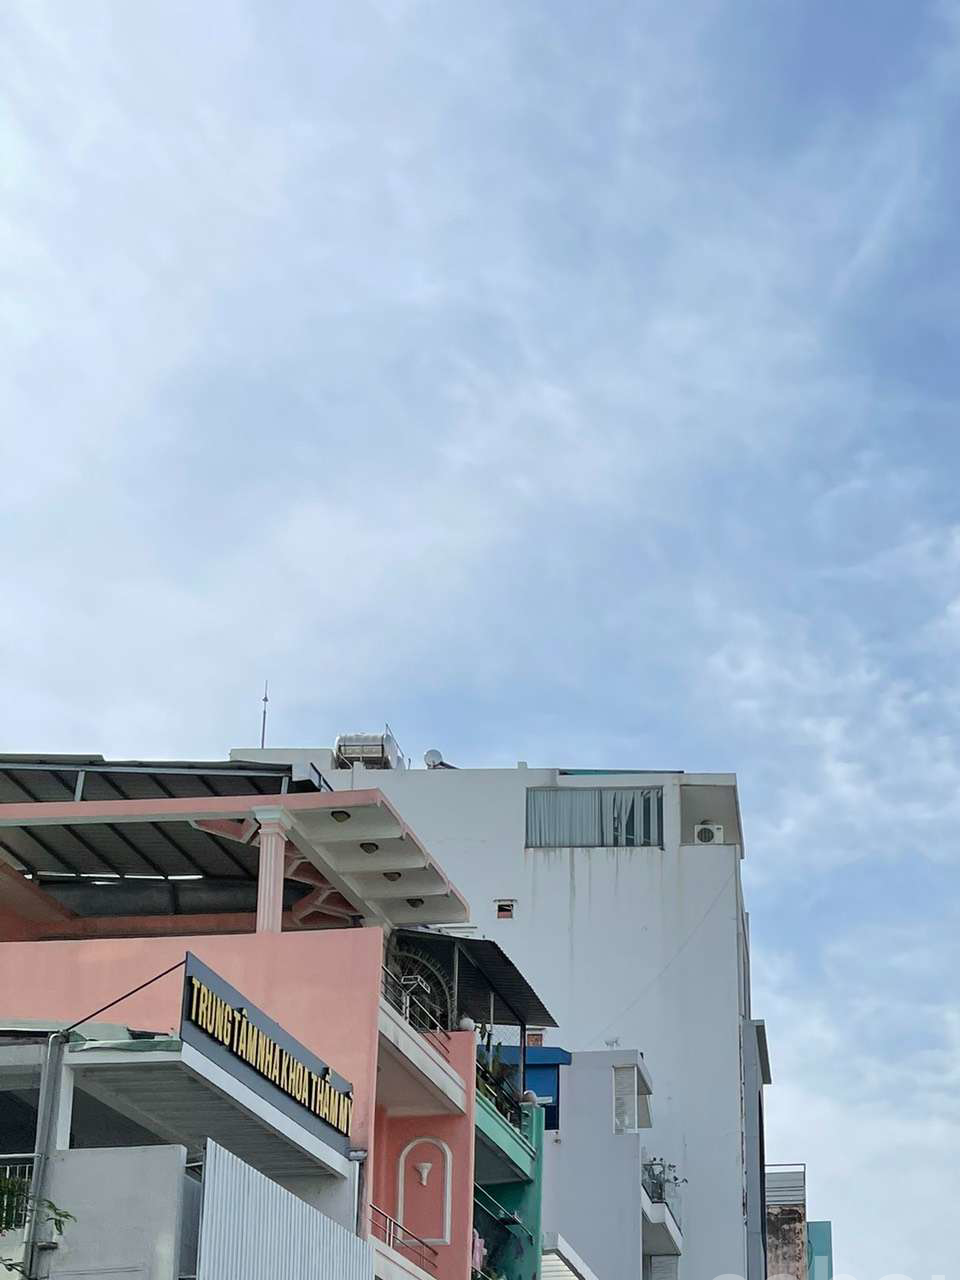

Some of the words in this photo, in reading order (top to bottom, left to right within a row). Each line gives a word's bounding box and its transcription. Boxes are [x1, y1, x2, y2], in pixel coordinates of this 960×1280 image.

[192, 977, 232, 1047] TRUNG
[233, 1008, 257, 1067] TÂM
[257, 1030, 280, 1086] NHA
[280, 1051, 309, 1108] KHOA
[310, 1067, 338, 1127] THẨM
